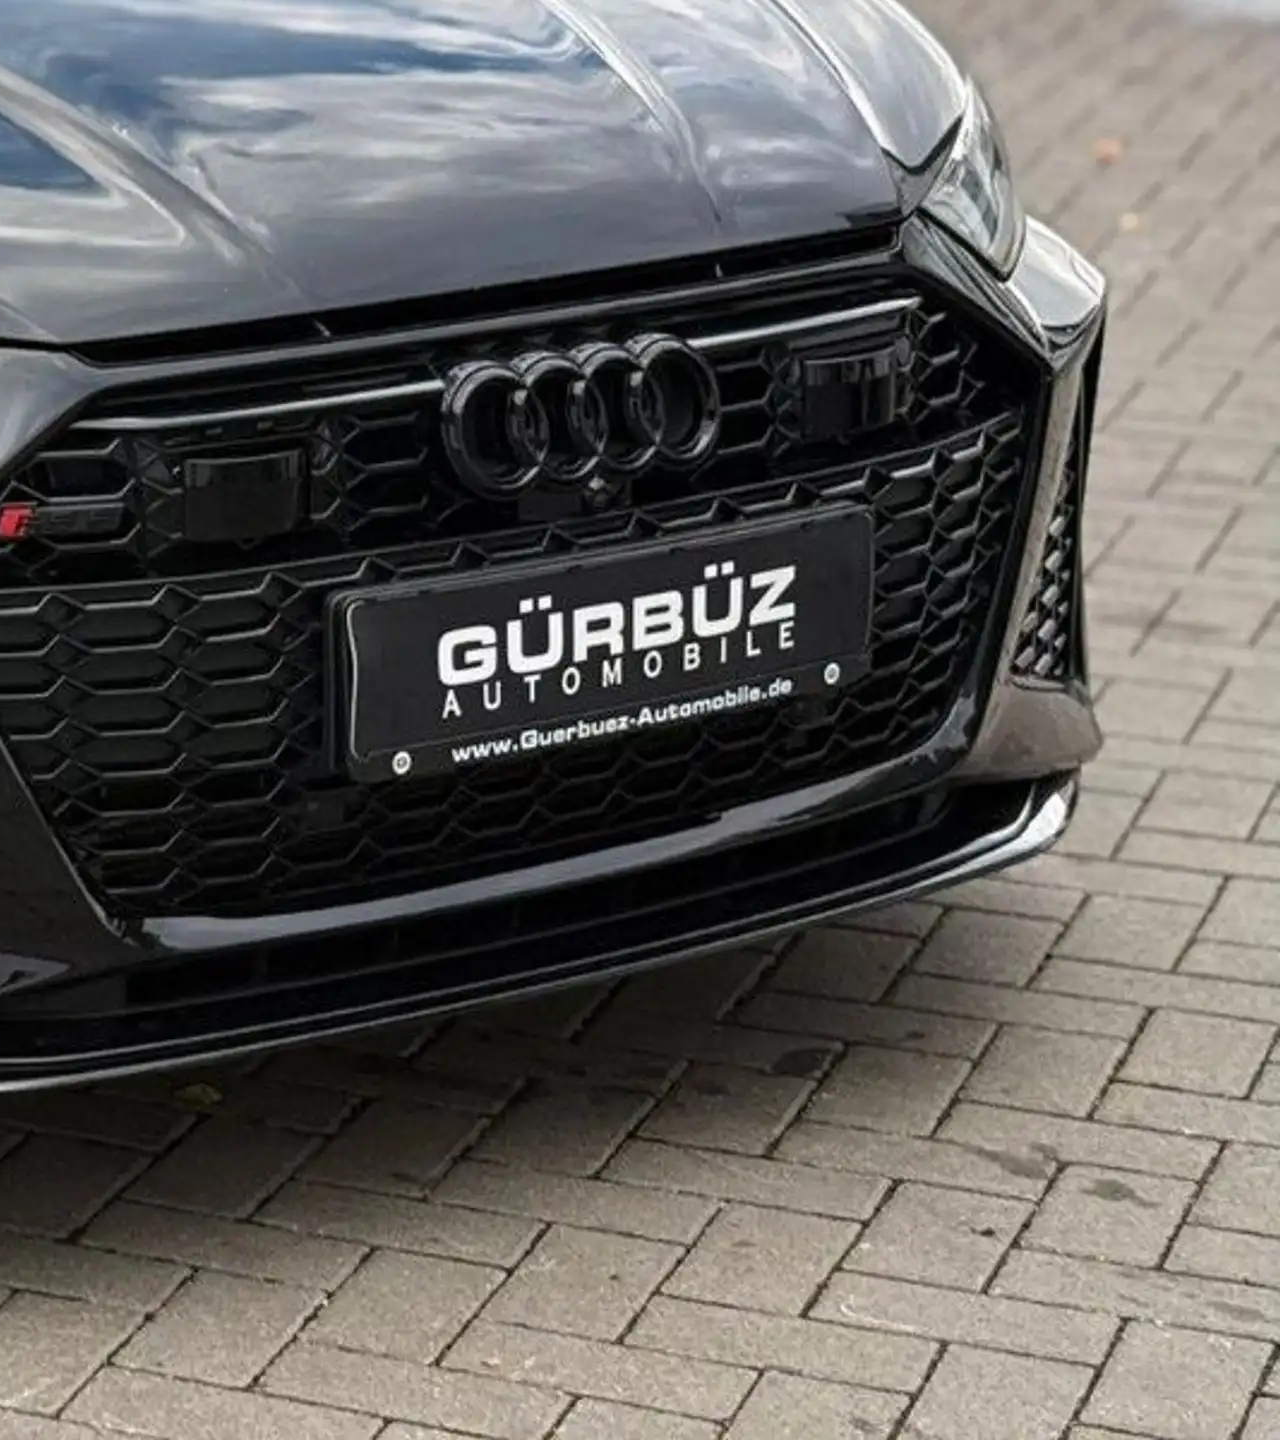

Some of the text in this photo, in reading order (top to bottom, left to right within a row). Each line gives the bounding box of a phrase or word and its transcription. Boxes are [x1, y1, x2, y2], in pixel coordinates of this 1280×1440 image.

[437, 560, 796, 686] GÜRBÜZ
[442, 620, 796, 719] AUTOMOBILE
[451, 677, 793, 764] www.Guerbuez-Automobile.de
